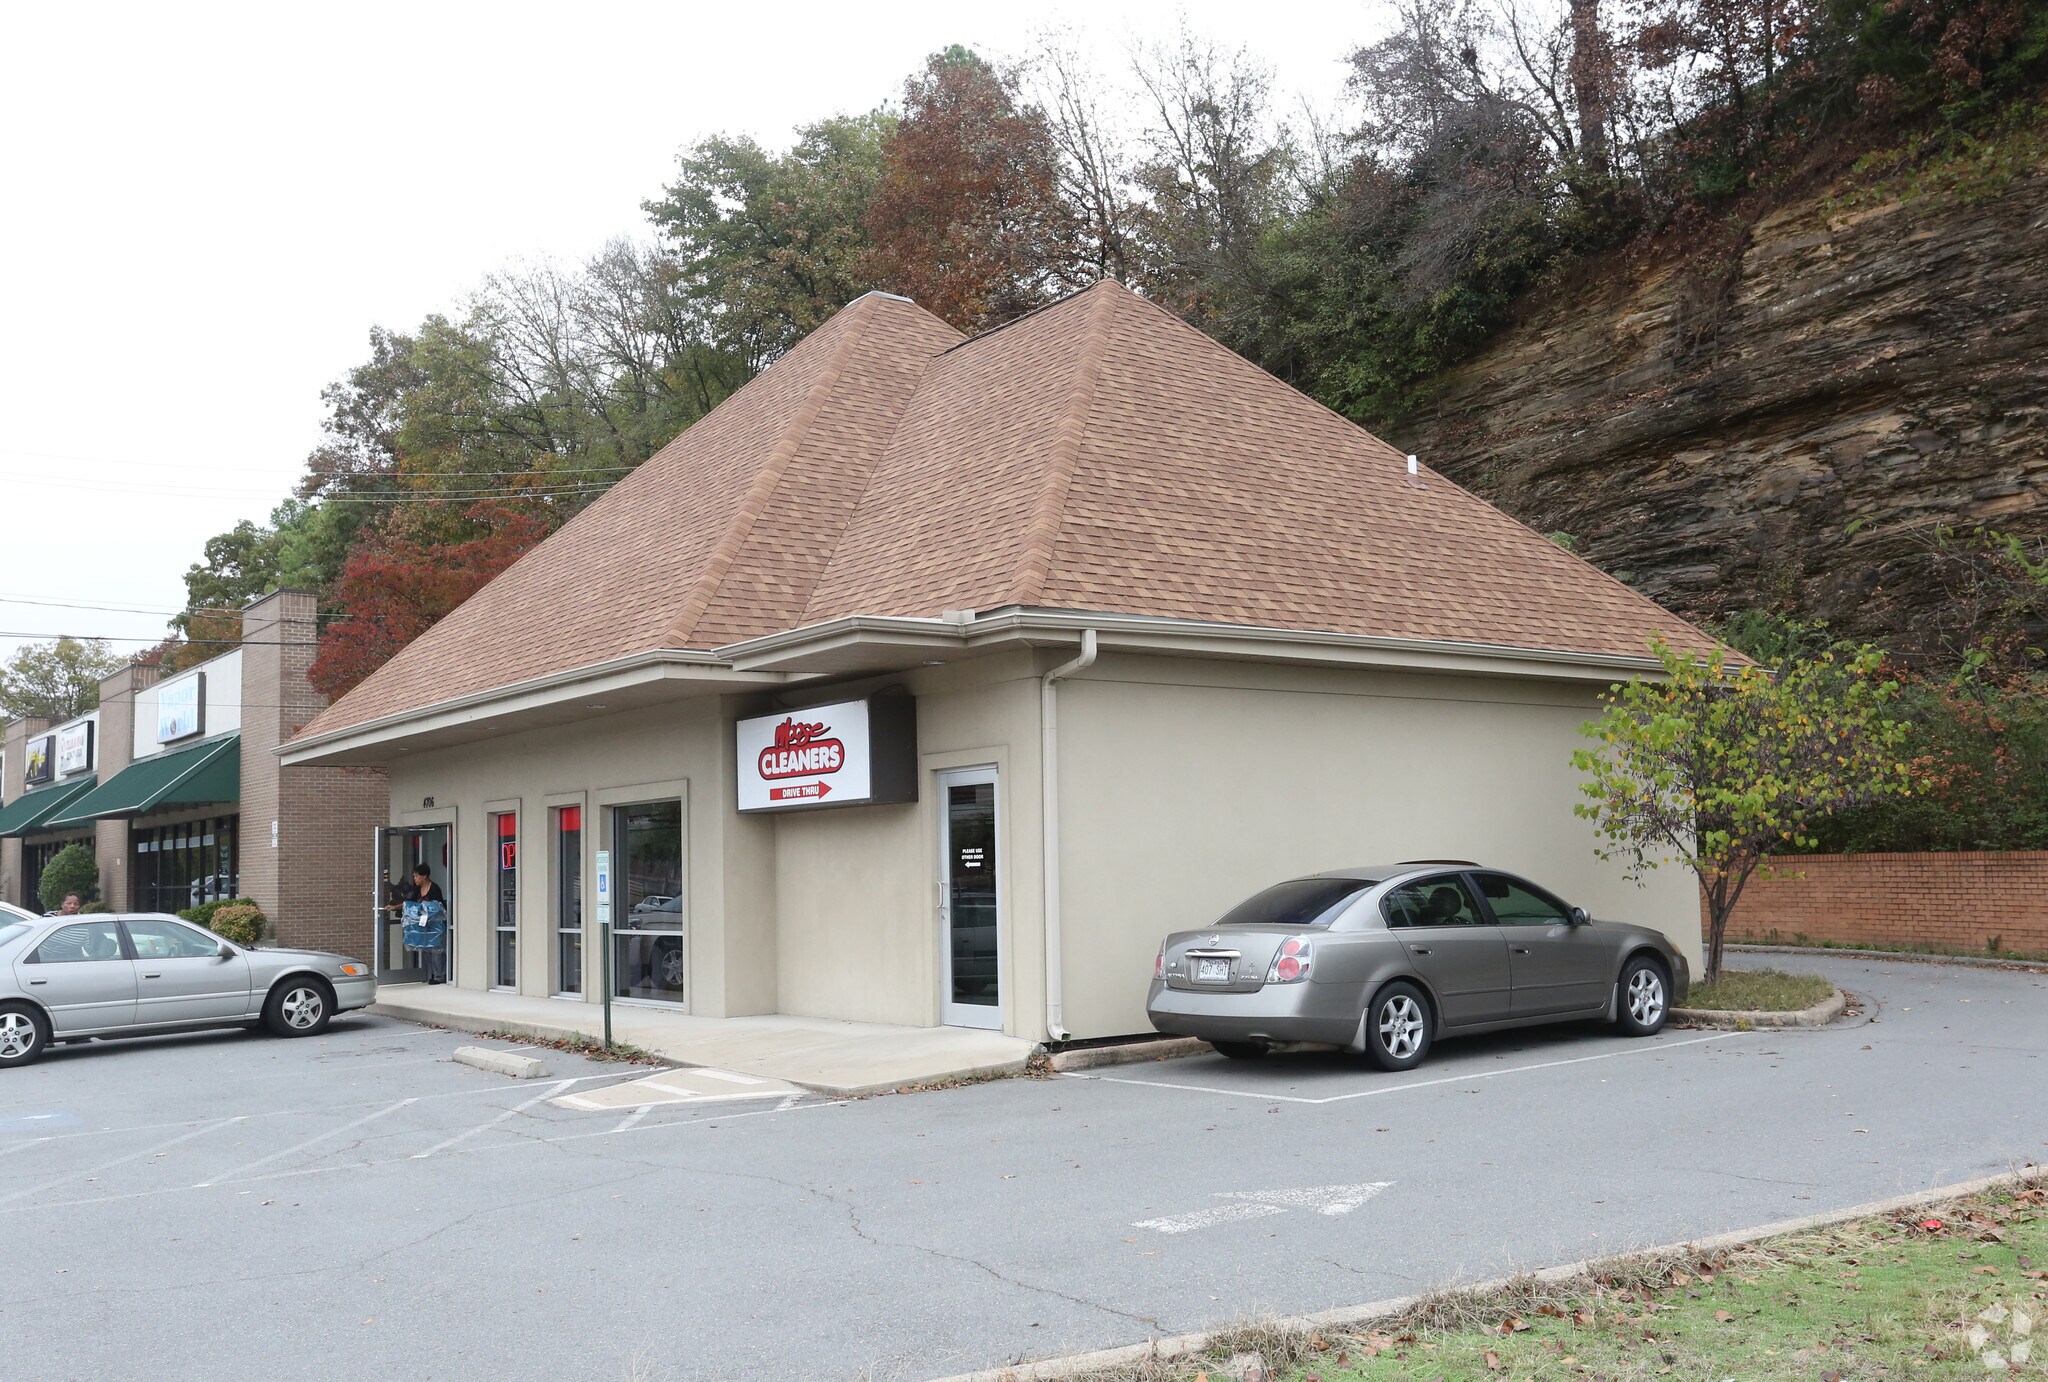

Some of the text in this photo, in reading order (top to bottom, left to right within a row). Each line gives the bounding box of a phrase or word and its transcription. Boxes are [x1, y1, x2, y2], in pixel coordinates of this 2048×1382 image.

[775, 716, 832, 750] Moose
[761, 744, 840, 776] CLEANERS
[782, 785, 820, 798] DRIVE THRU
[503, 843, 516, 868] OP
